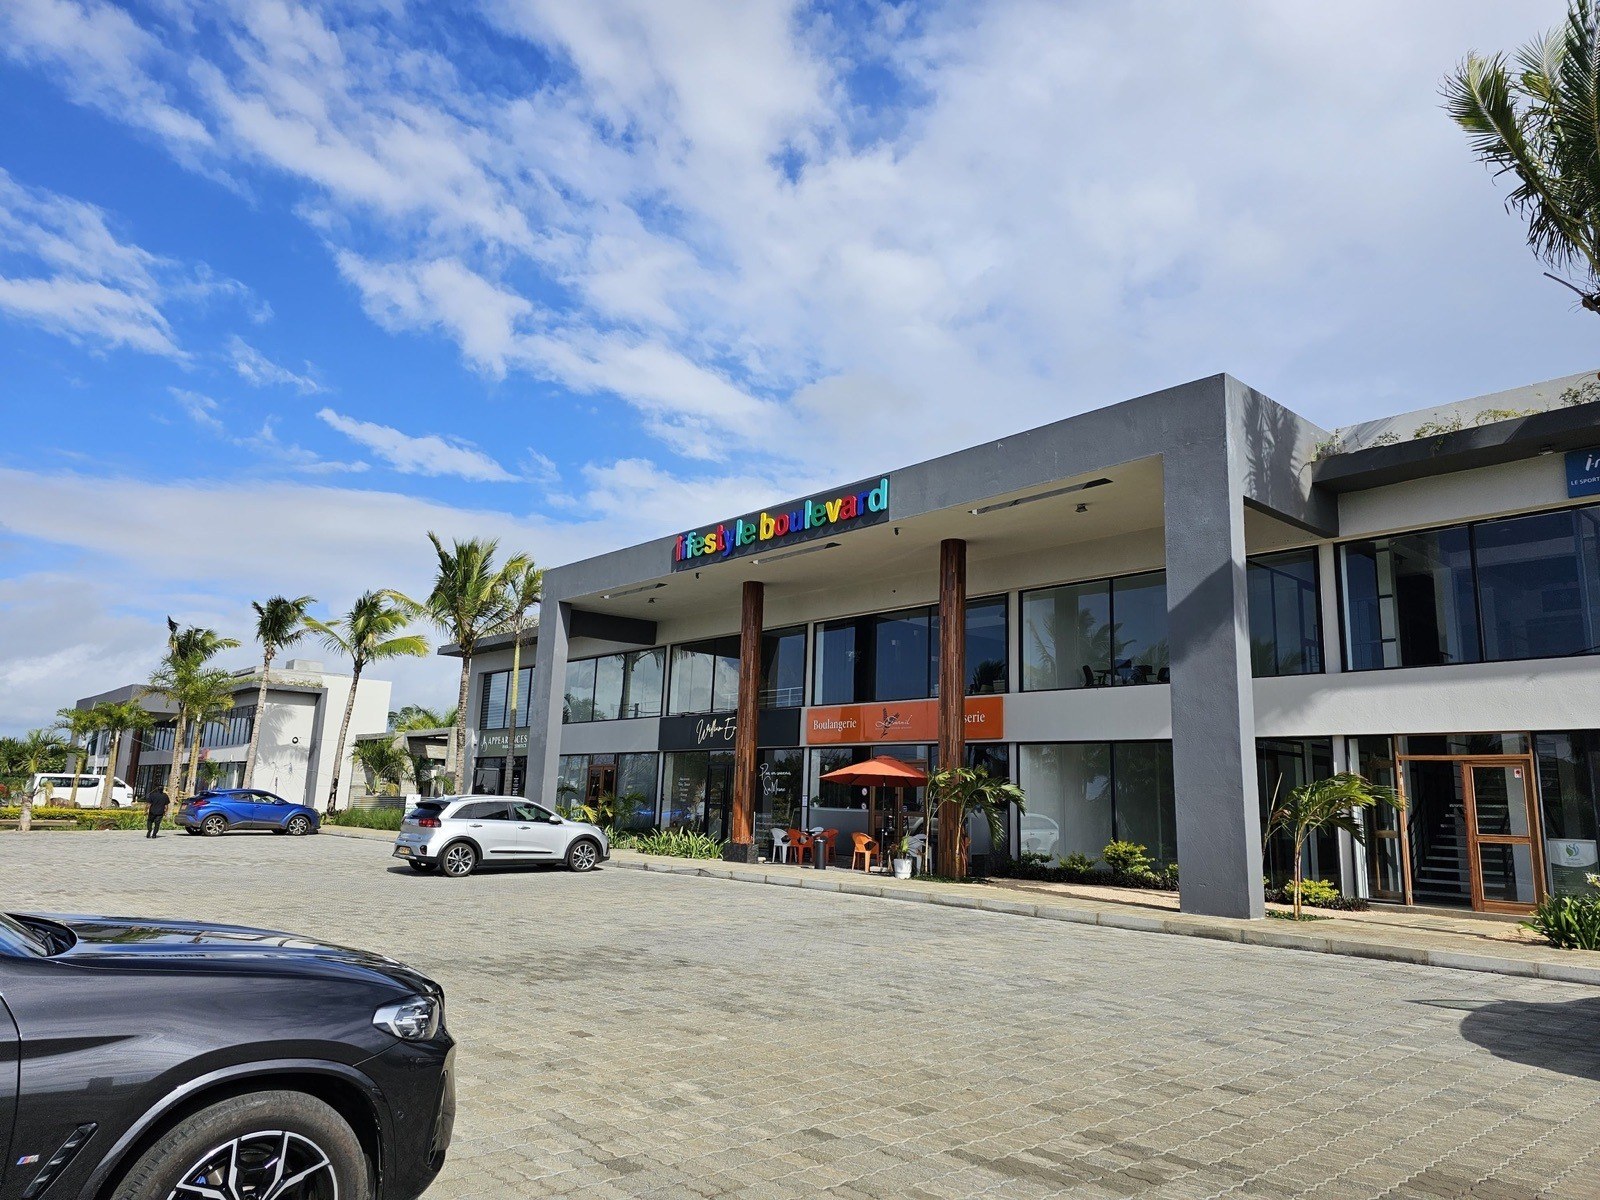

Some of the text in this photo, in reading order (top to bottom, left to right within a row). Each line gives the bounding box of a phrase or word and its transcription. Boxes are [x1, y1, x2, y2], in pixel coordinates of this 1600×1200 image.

[1580, 477, 1600, 485] SPORT
[676, 478, 888, 562] lifestyle boulevard
[964, 711, 985, 723] serie
[813, 718, 857, 731] Boulangerie
